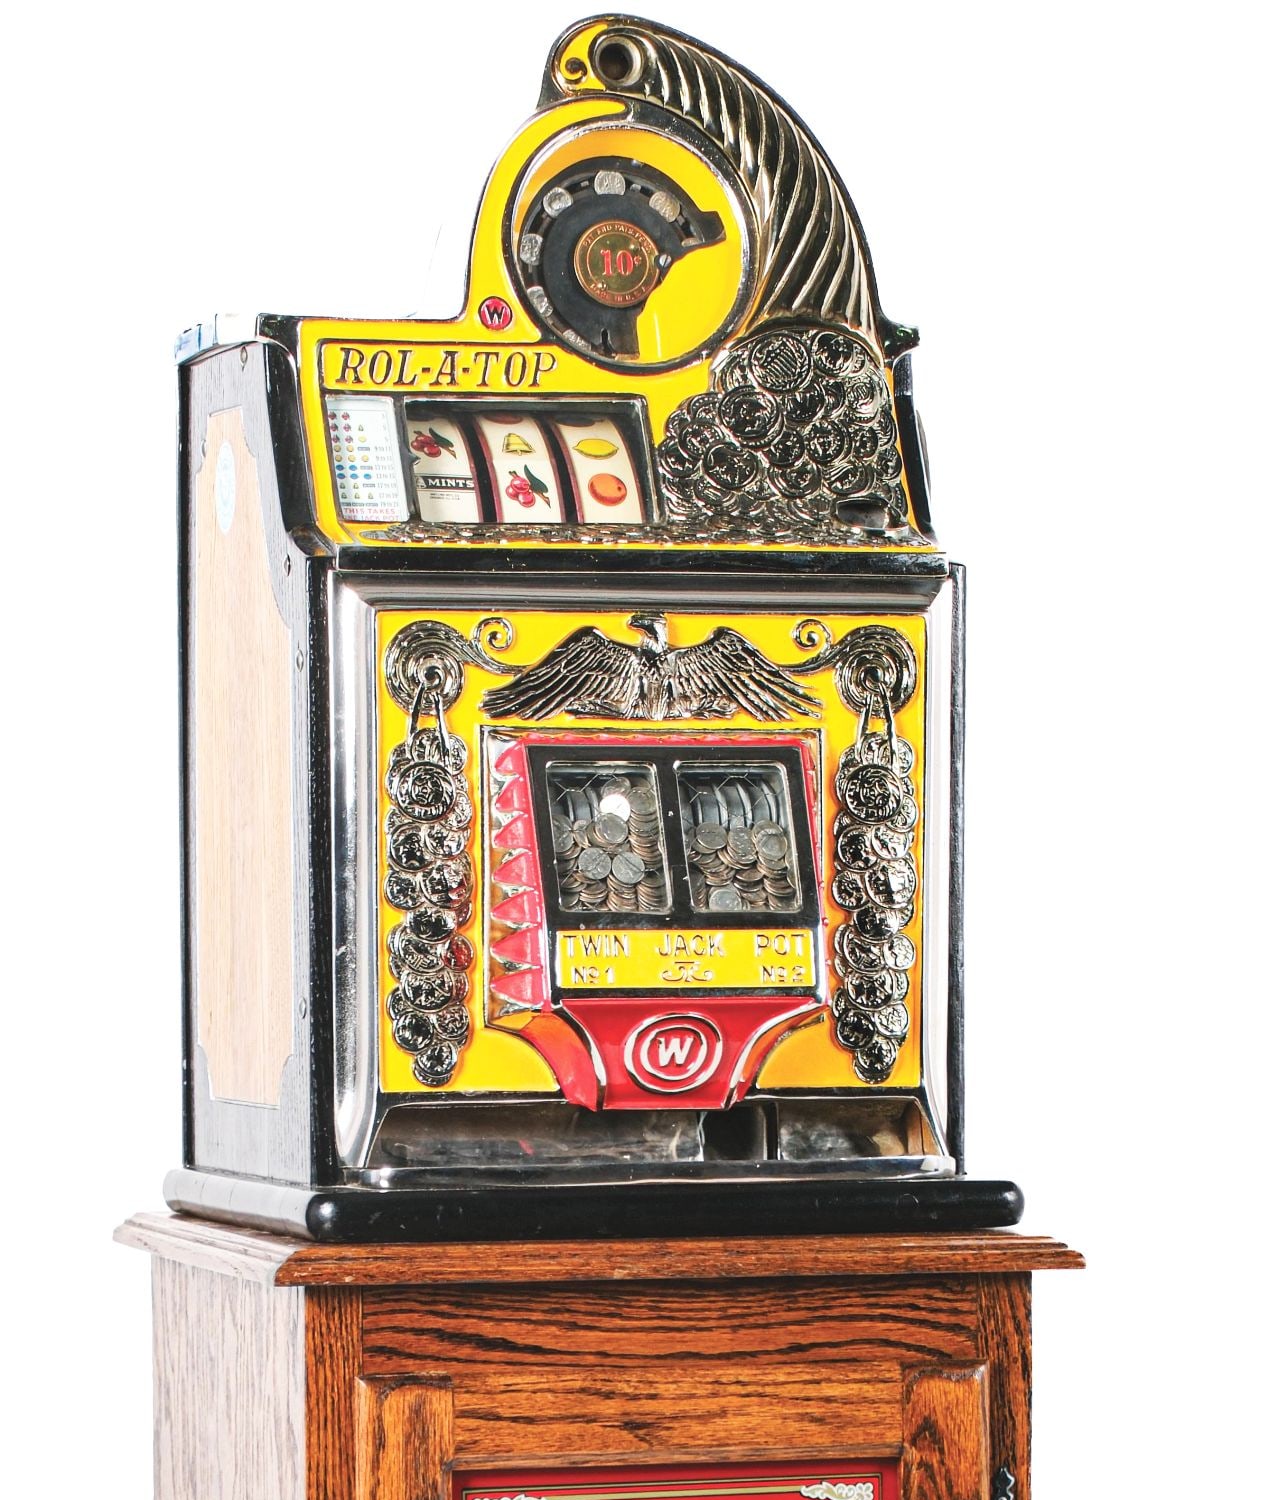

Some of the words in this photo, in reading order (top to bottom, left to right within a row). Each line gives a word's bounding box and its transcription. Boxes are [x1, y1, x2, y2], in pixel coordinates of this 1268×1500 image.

[485, 305, 506, 324] W
[335, 347, 558, 388] ROL-A-TOP
[427, 478, 475, 488] MINTS
[562, 934, 630, 957] TWIN
[657, 934, 725, 957] JACK
[756, 934, 805, 957] POT
[658, 1036, 694, 1066] W
